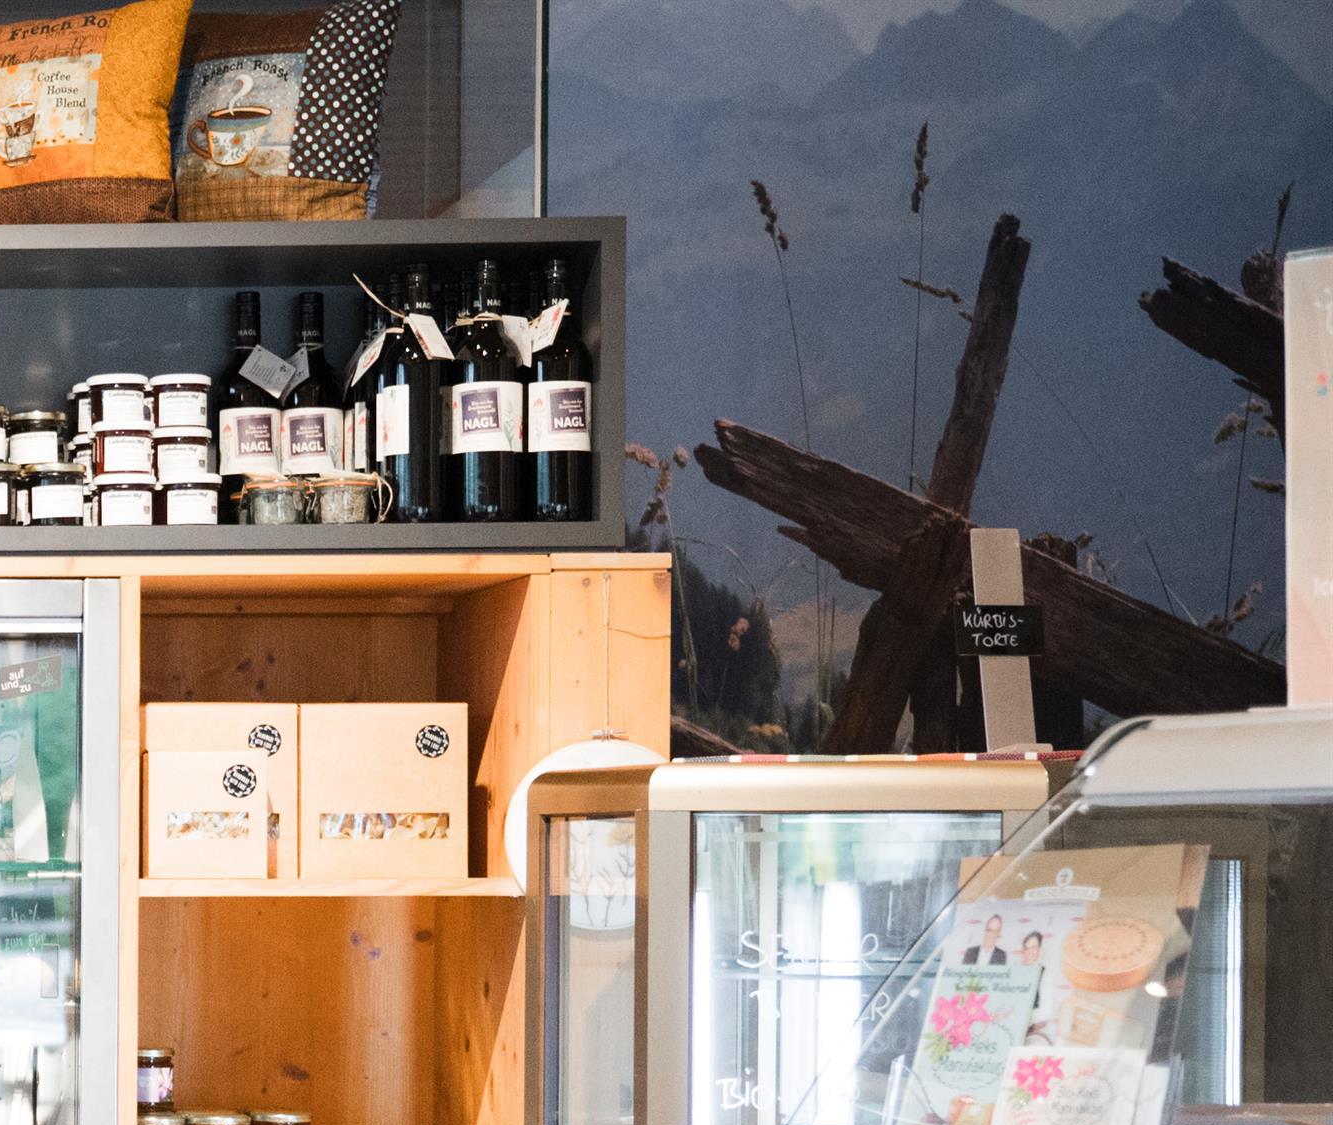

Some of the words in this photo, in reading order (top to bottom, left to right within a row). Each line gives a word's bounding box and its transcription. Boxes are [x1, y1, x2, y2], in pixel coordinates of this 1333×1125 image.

[7, 21, 73, 42] French
[83, 15, 112, 29] Ro
[37, 71, 71, 83] Coffee
[202, 60, 244, 86] French
[253, 60, 289, 82] Roast
[46, 85, 79, 96] House
[55, 97, 86, 109] Blend
[464, 416, 497, 430] NAGL
[554, 416, 584, 428] NAGL
[240, 441, 271, 453] NAGL
[292, 441, 324, 453] NAGL
[971, 632, 1019, 647] TORTE
[9, 668, 24, 680] auf
[1, 680, 19, 690] und
[20, 684, 31, 693] zu
